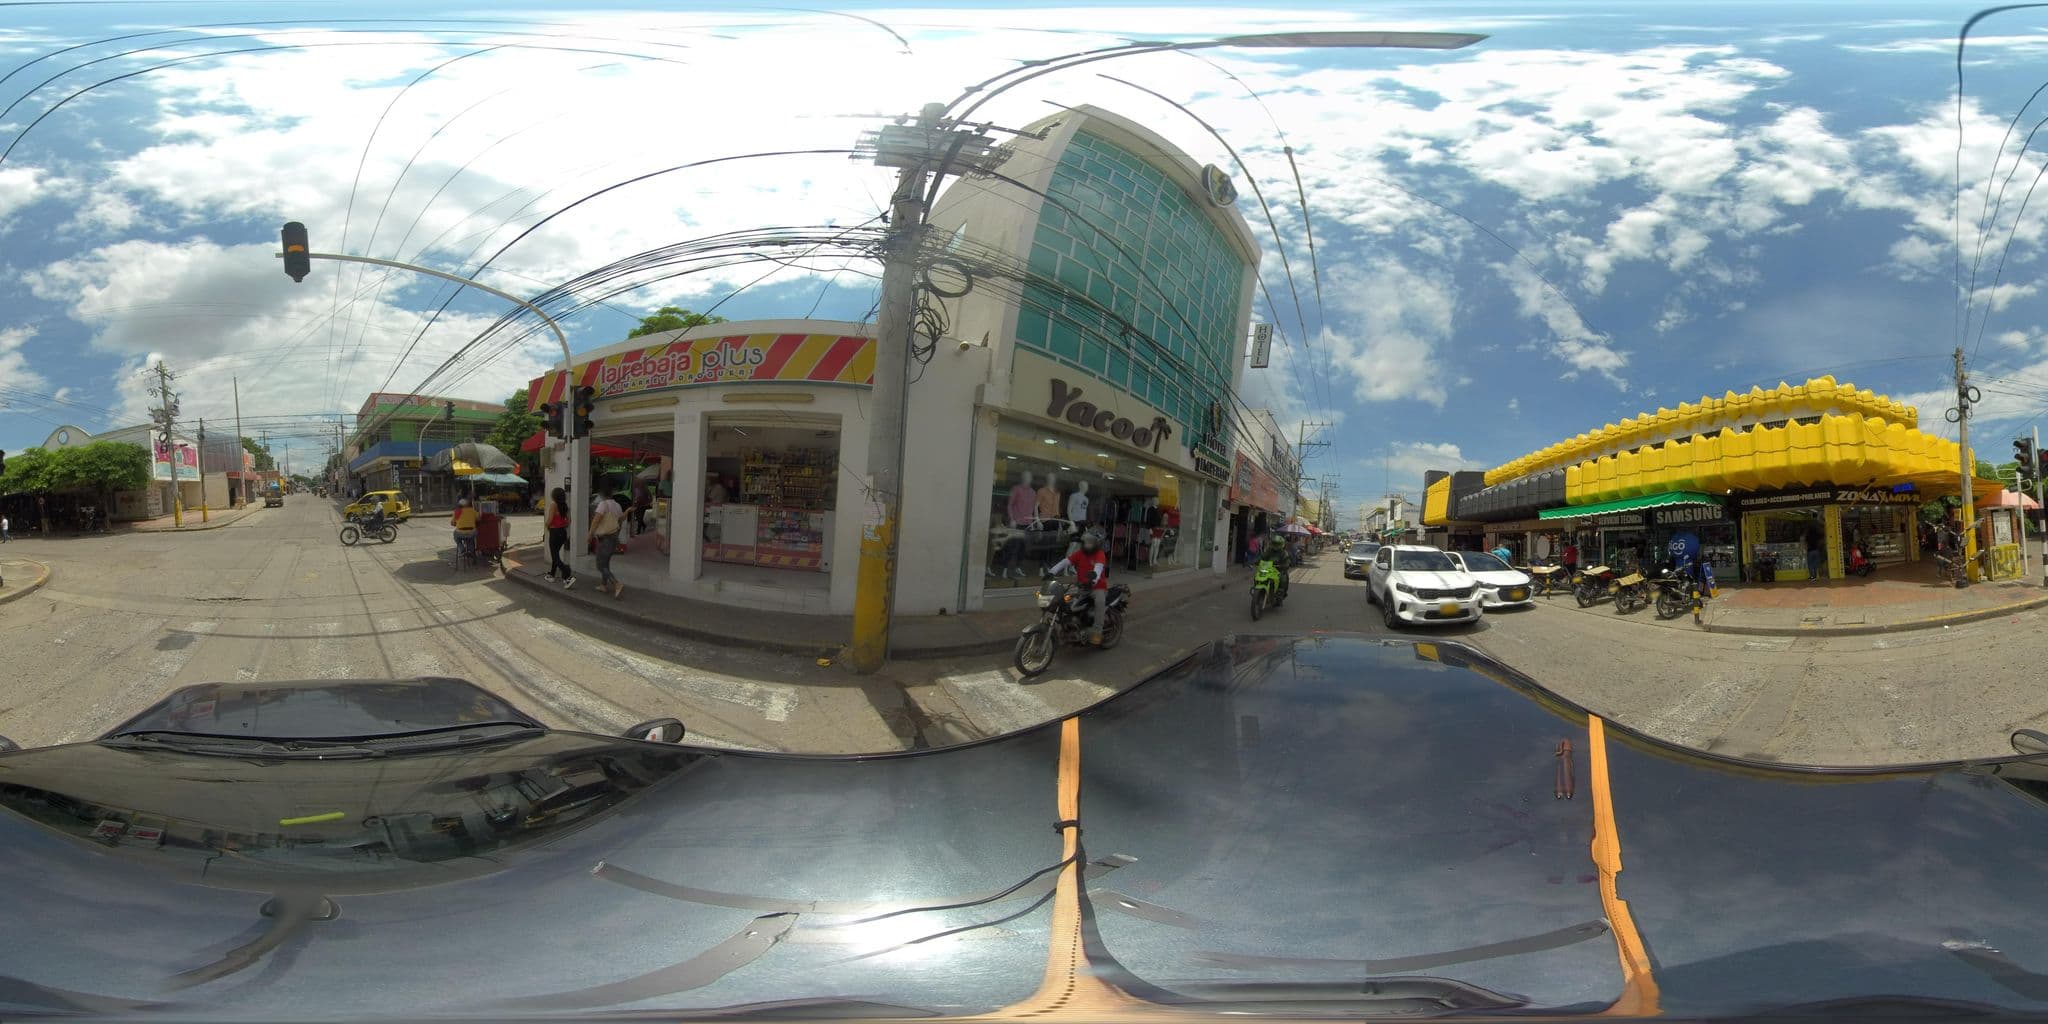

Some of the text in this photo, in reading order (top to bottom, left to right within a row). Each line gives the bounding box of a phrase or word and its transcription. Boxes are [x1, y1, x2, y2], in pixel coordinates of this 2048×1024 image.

[1255, 326, 1267, 365] HOTEL
[601, 342, 764, 384] la rebaja plus
[1205, 431, 1227, 458] HOTEL
[1836, 490, 1880, 502] ZONA
[1656, 506, 1723, 524] SAMSUNG
